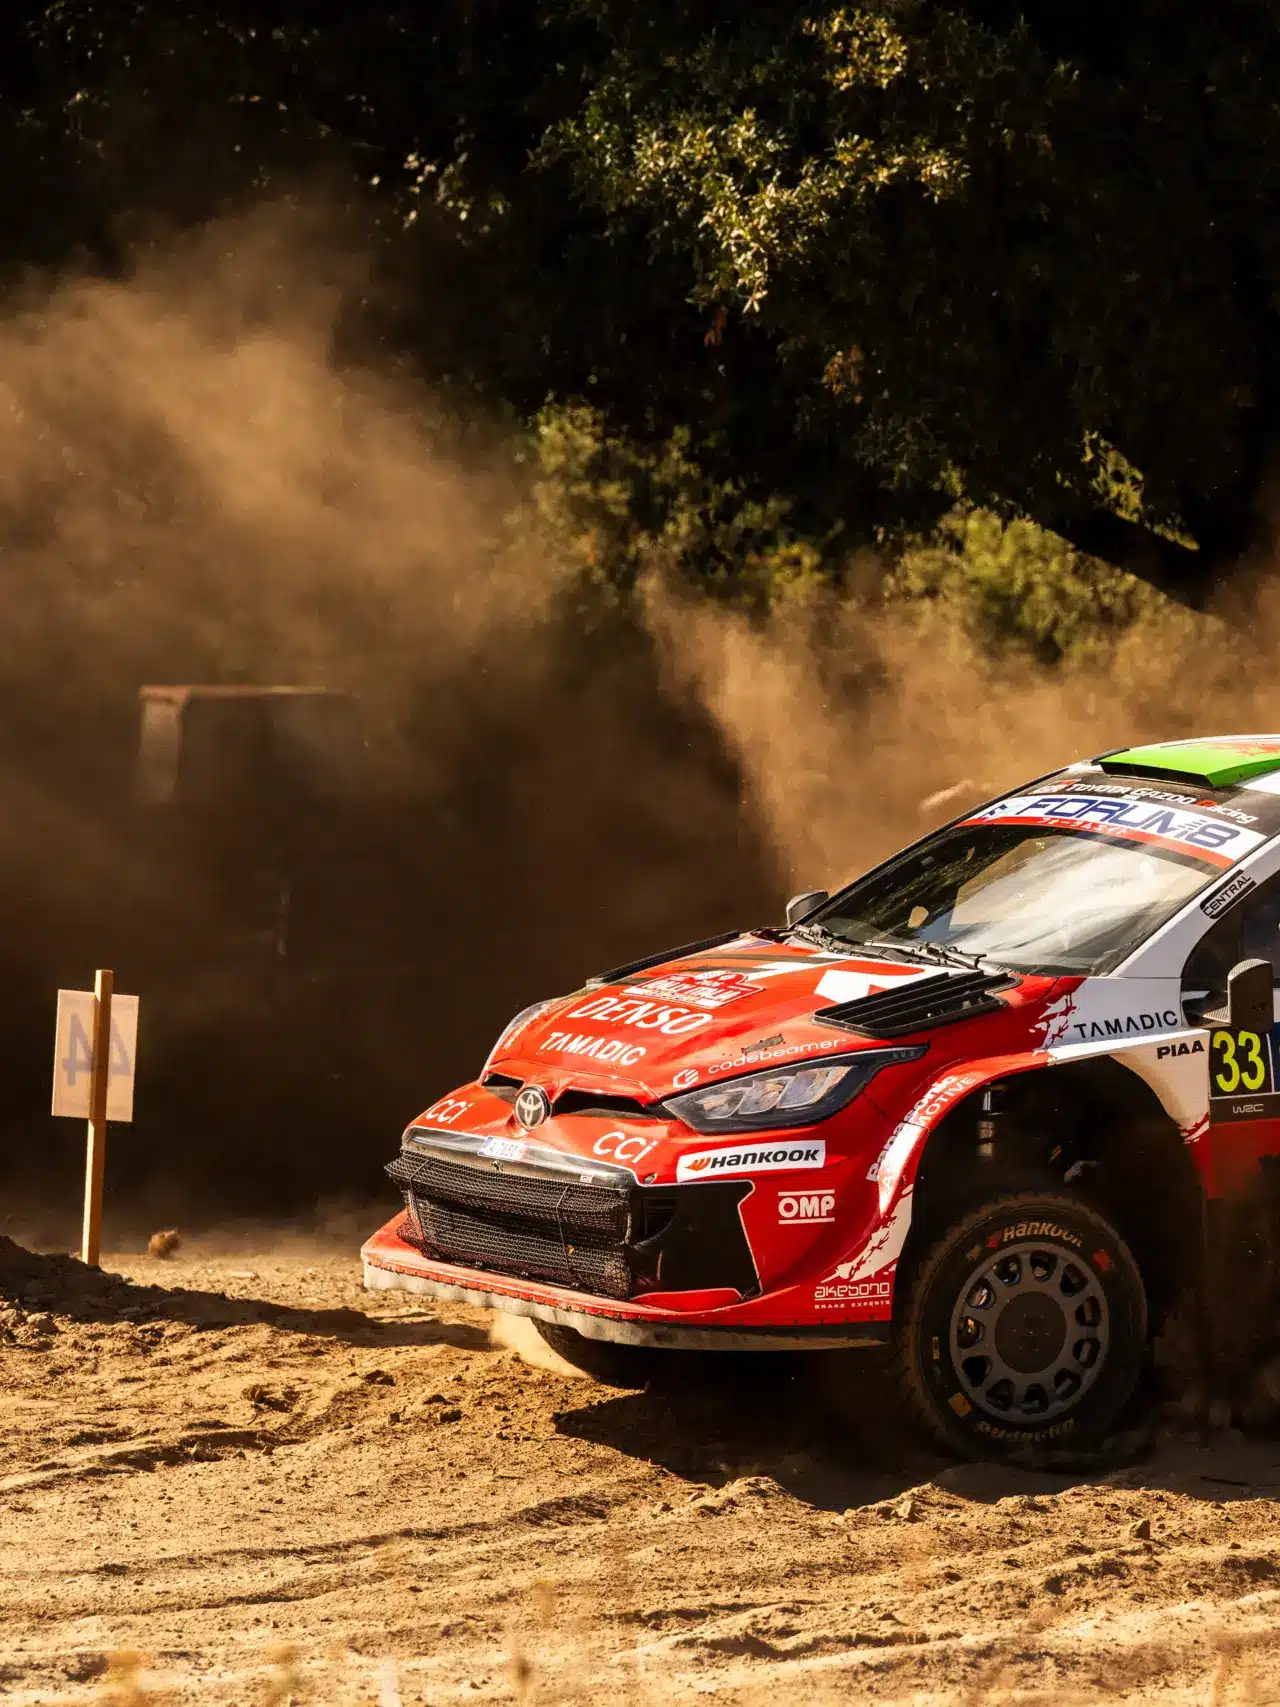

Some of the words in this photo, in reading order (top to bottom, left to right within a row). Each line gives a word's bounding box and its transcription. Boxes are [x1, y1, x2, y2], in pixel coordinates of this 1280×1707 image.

[1069, 783, 1126, 794] TOYOTA
[1202, 875, 1252, 917] CENTRAL
[566, 996, 713, 1035] DENSO
[1073, 1010, 1178, 1039] TAMADIC
[539, 1032, 647, 1066] TAMADIC
[708, 1038, 843, 1074] codebeamer
[1156, 1041, 1205, 1060] PIAA
[1212, 1030, 1266, 1093] 33
[1232, 1103, 1264, 1114] WRC
[778, 1195, 835, 1218] OMP
[851, 1300, 890, 1308] EXPERTS
